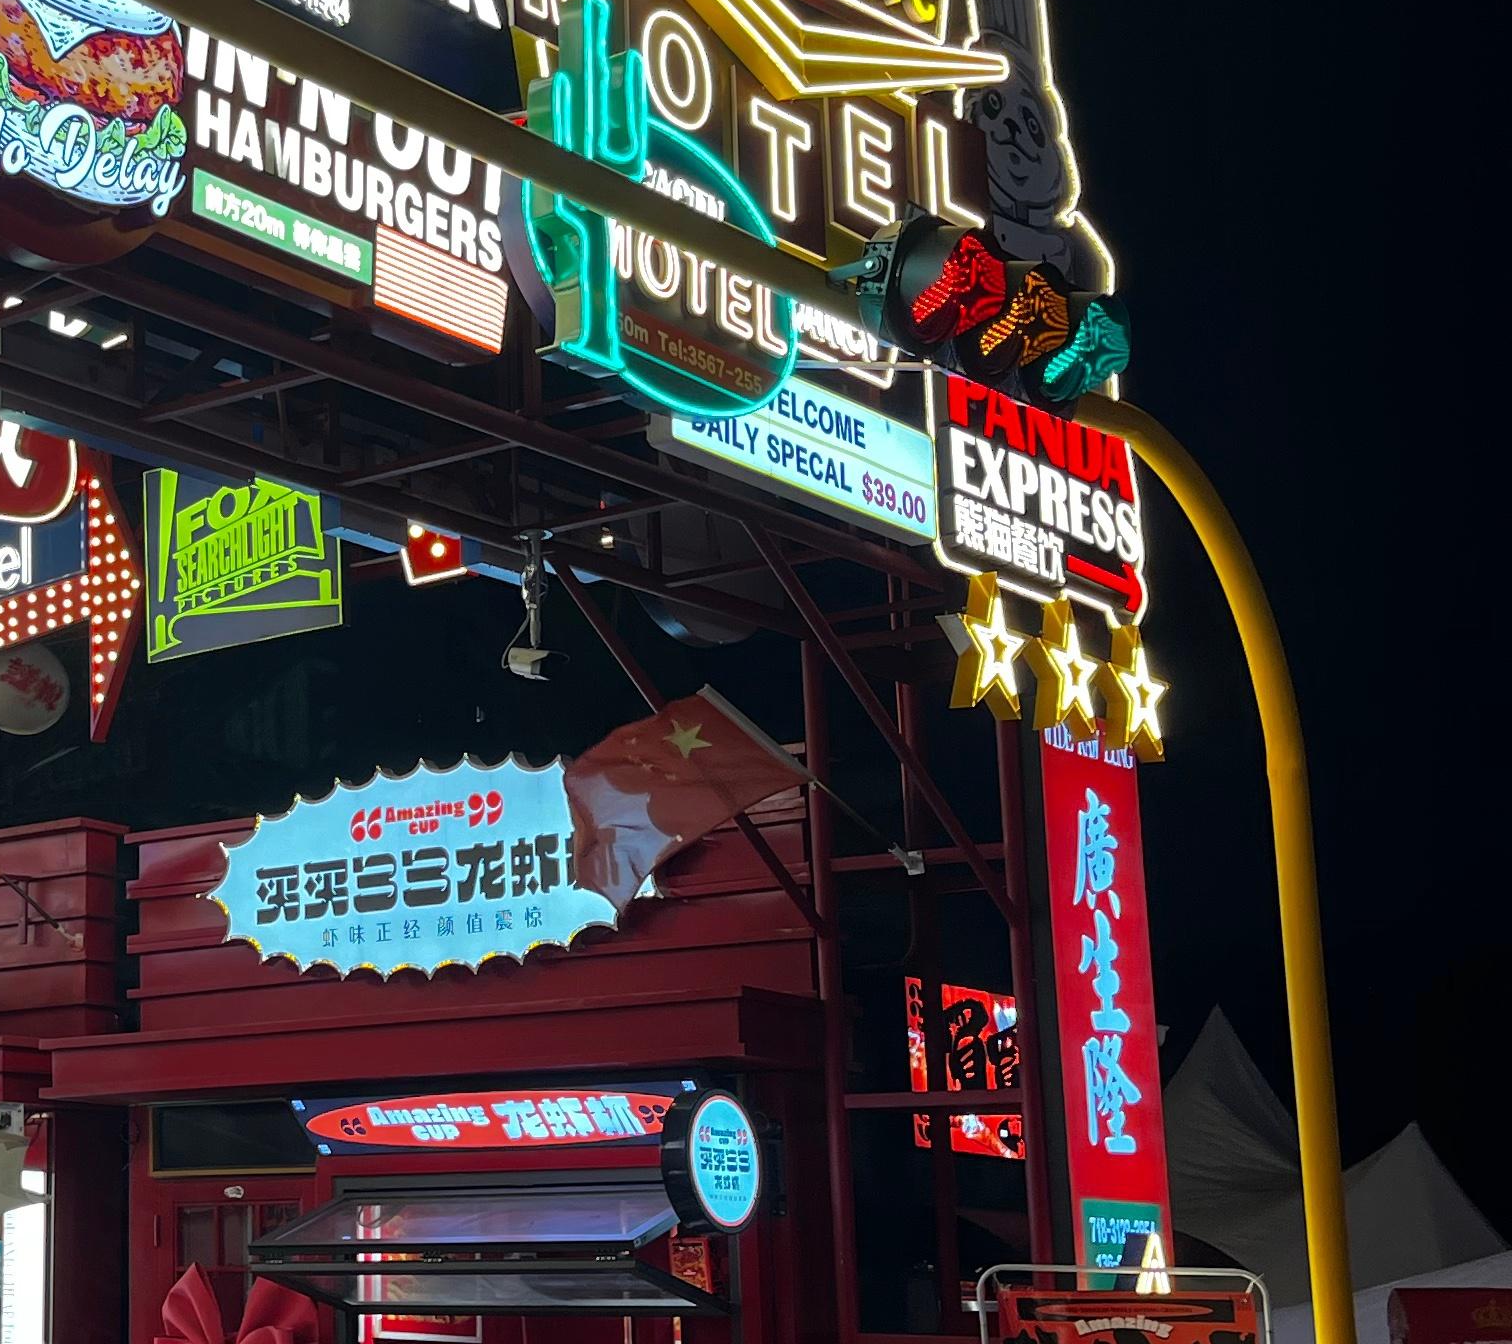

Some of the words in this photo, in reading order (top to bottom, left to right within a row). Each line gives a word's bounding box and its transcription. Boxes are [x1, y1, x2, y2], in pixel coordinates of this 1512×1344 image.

[41, 102, 185, 218] Delay
[196, 89, 503, 272] HAMBURGERS
[691, 415, 759, 455] DAILY
[767, 434, 853, 493] SPECAL
[862, 471, 926, 524] $39.00
[947, 374, 1134, 503] PANDA
[176, 477, 293, 551] FOX
[949, 427, 1141, 562] EXPRESS
[954, 494, 1066, 585] 熊猫餐饮
[177, 500, 298, 592] SEARCHLIGHT
[178, 554, 298, 613] PICTURES
[384, 799, 466, 824] Amazing
[436, 906, 543, 938] 颜值震惊
[366, 1103, 489, 1126] Amazing
